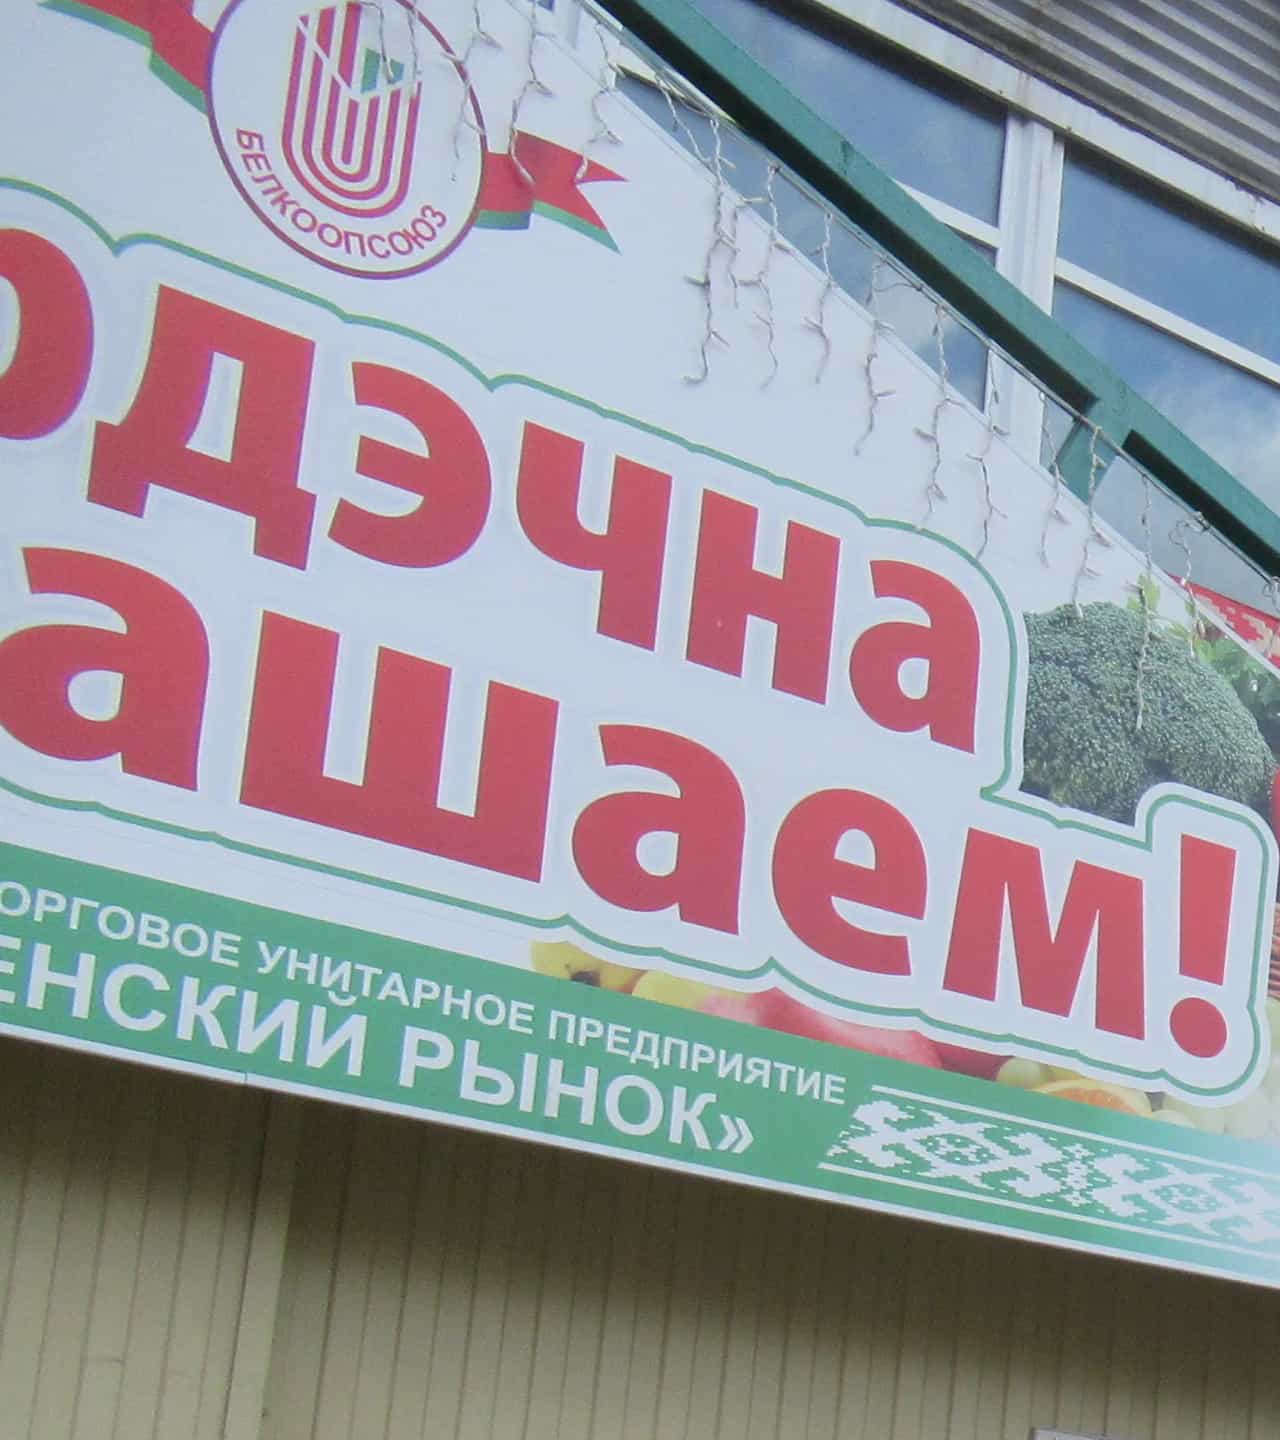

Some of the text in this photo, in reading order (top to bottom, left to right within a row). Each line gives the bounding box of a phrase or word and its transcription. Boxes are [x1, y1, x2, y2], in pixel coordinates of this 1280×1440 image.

[236, 126, 449, 261] БЕЛКООПСОЮЗ
[0, 547, 1237, 1058] ашаем!
[257, 940, 534, 1034] УНИТАРНОЕ
[547, 1010, 847, 1106] ПРЕДПРИЯТИЕ
[398, 1024, 756, 1156] РЫНОК»
